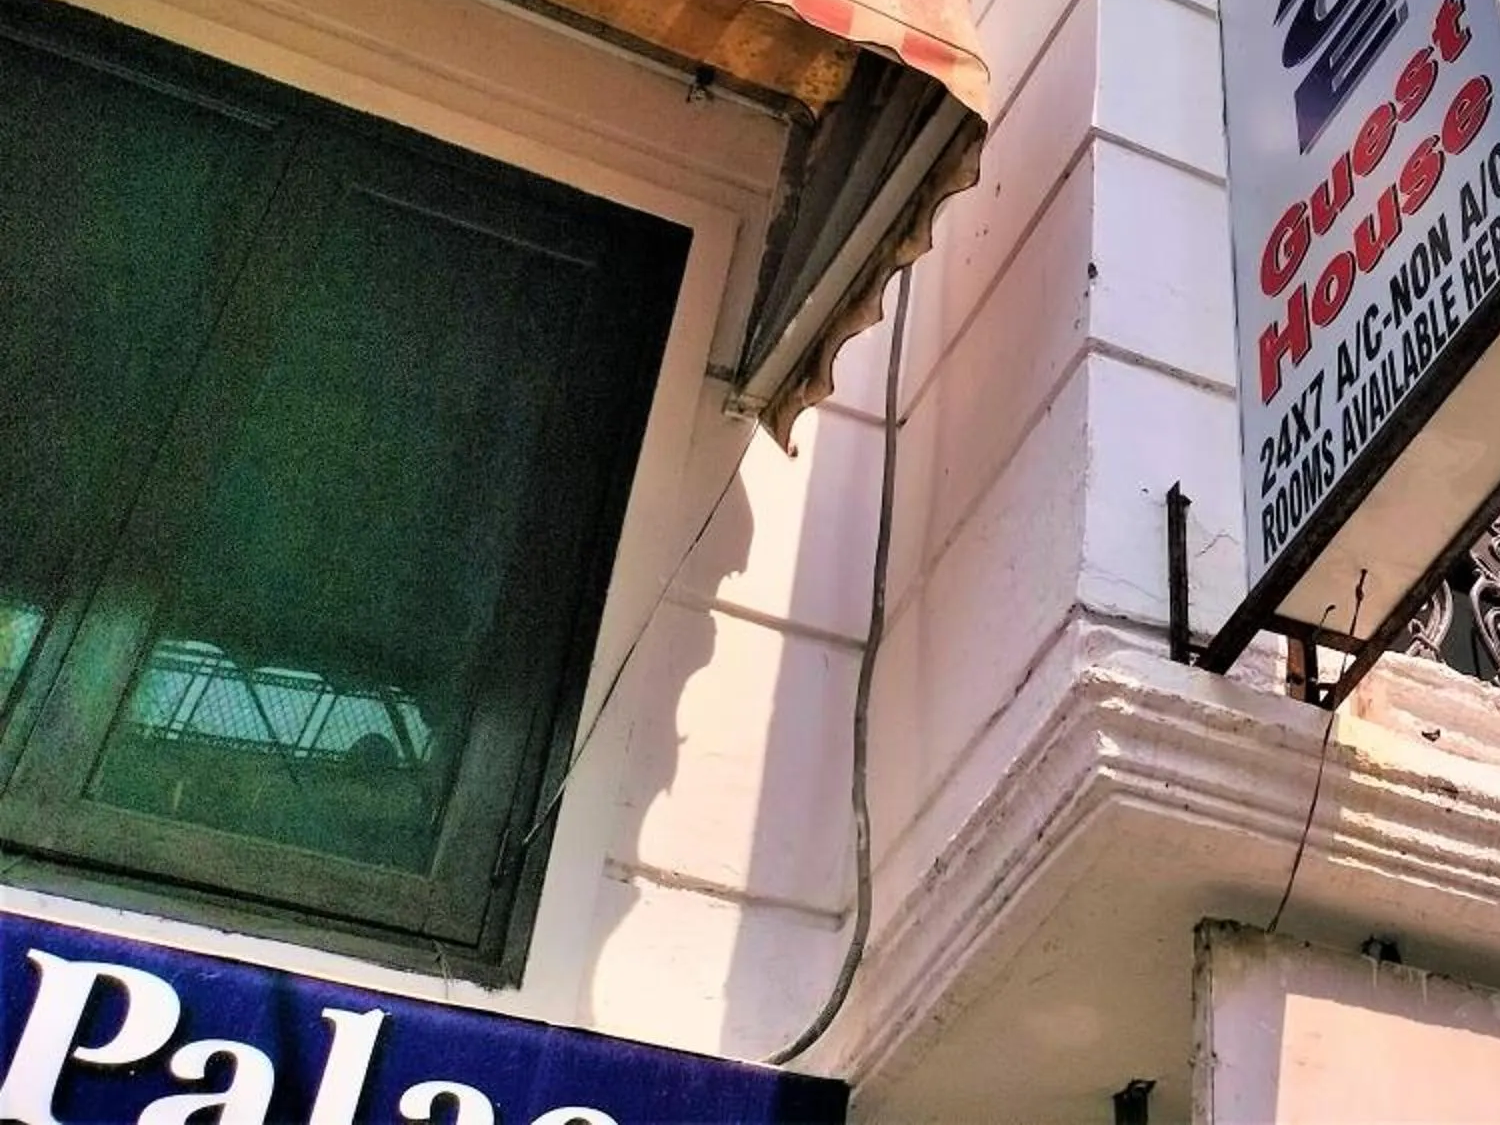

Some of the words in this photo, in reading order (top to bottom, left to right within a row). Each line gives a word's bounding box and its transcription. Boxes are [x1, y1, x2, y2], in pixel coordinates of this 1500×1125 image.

[1257, 74, 1493, 405] House
[1259, 369, 1326, 498] 24X7
[1336, 213, 1452, 400] A/C-NON
[1261, 442, 1336, 564] ROOMS
[1342, 293, 1461, 465] AVAILABLE
